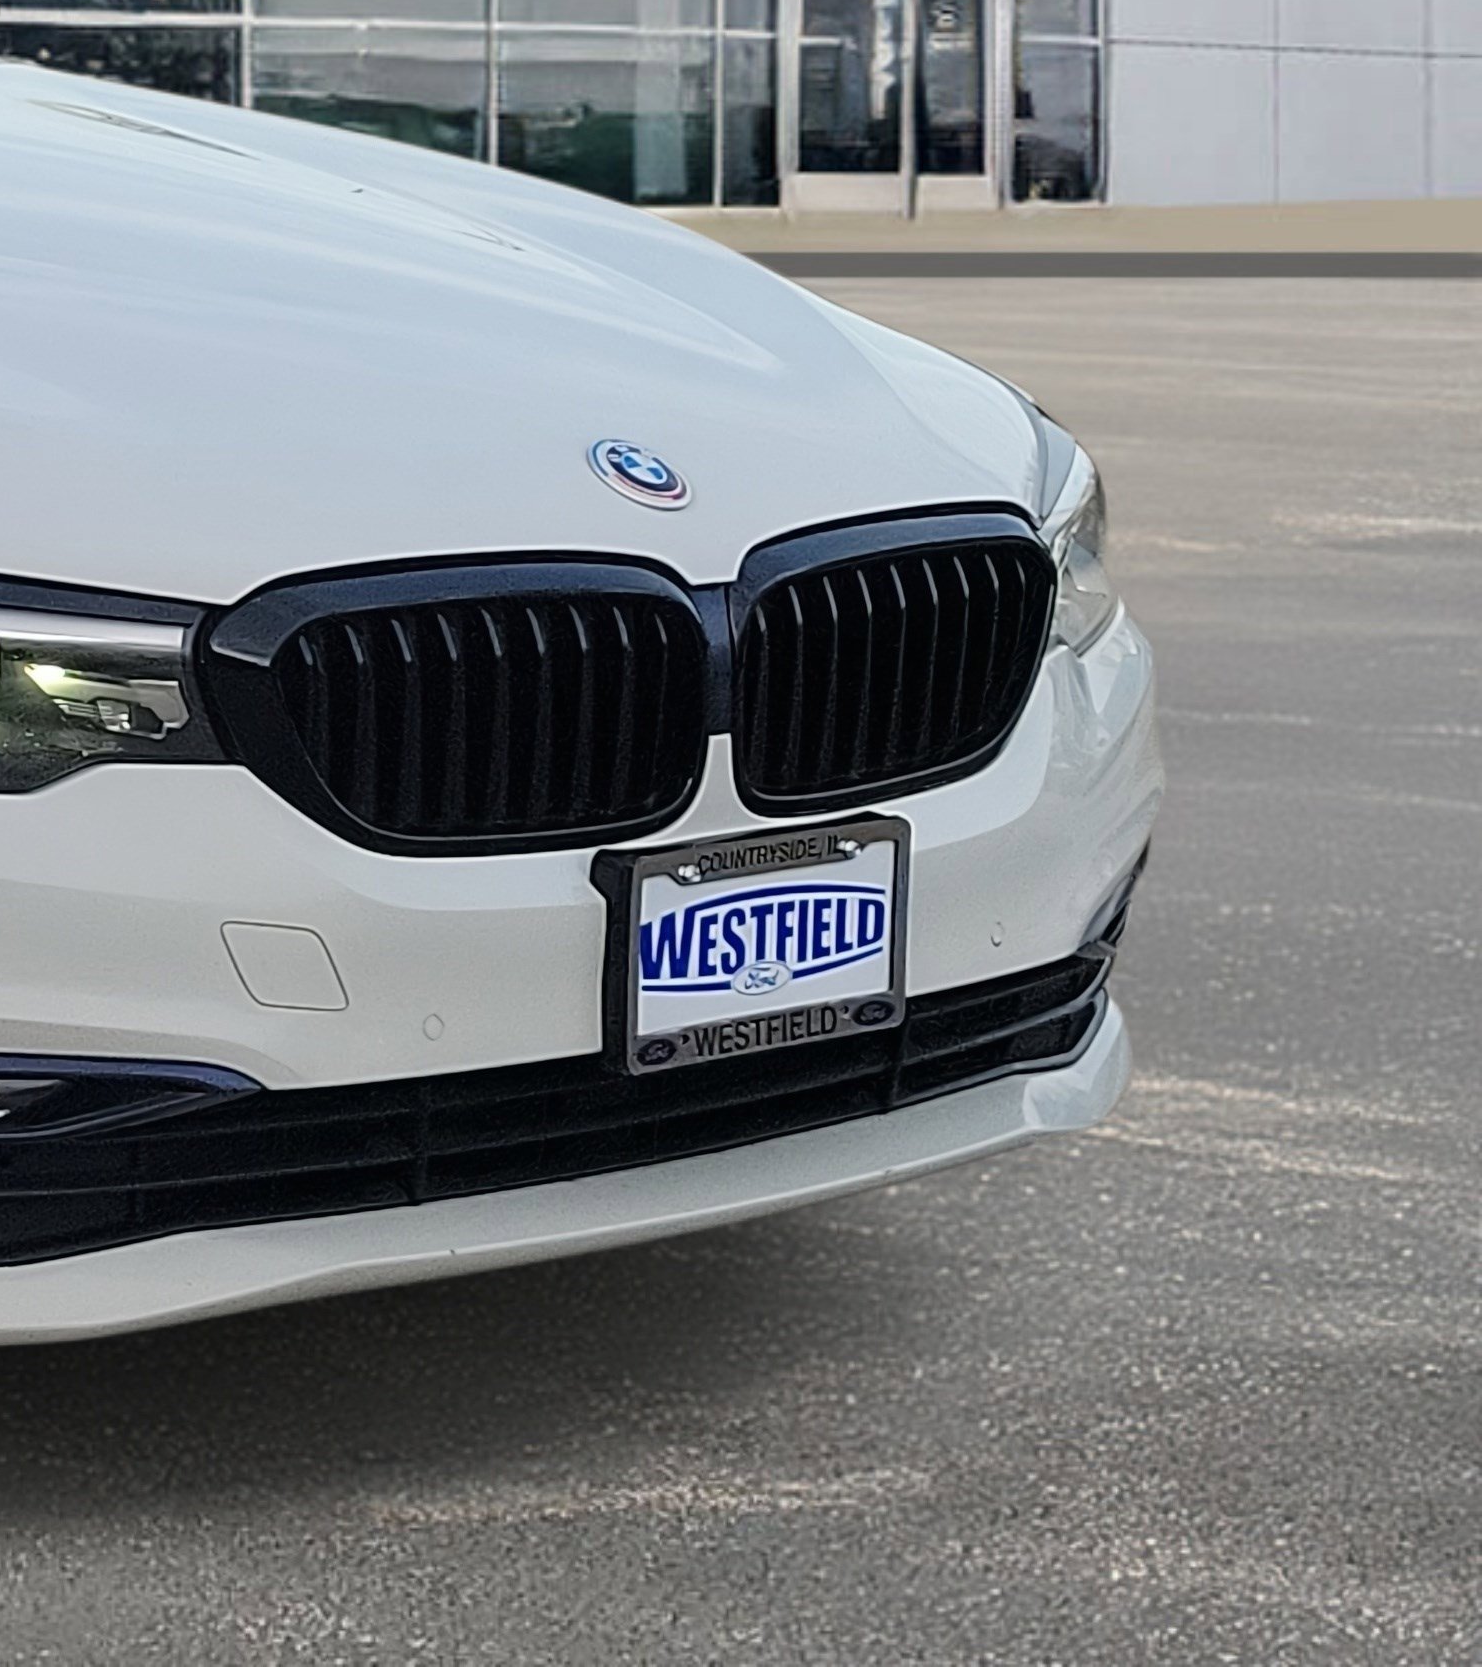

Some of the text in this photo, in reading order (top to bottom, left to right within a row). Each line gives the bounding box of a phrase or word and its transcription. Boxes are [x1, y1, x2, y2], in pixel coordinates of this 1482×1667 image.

[697, 837, 823, 875] COUNTRYSIDE,
[639, 898, 885, 980] WESTFIELD
[693, 1005, 837, 1057] WESTFIELD
